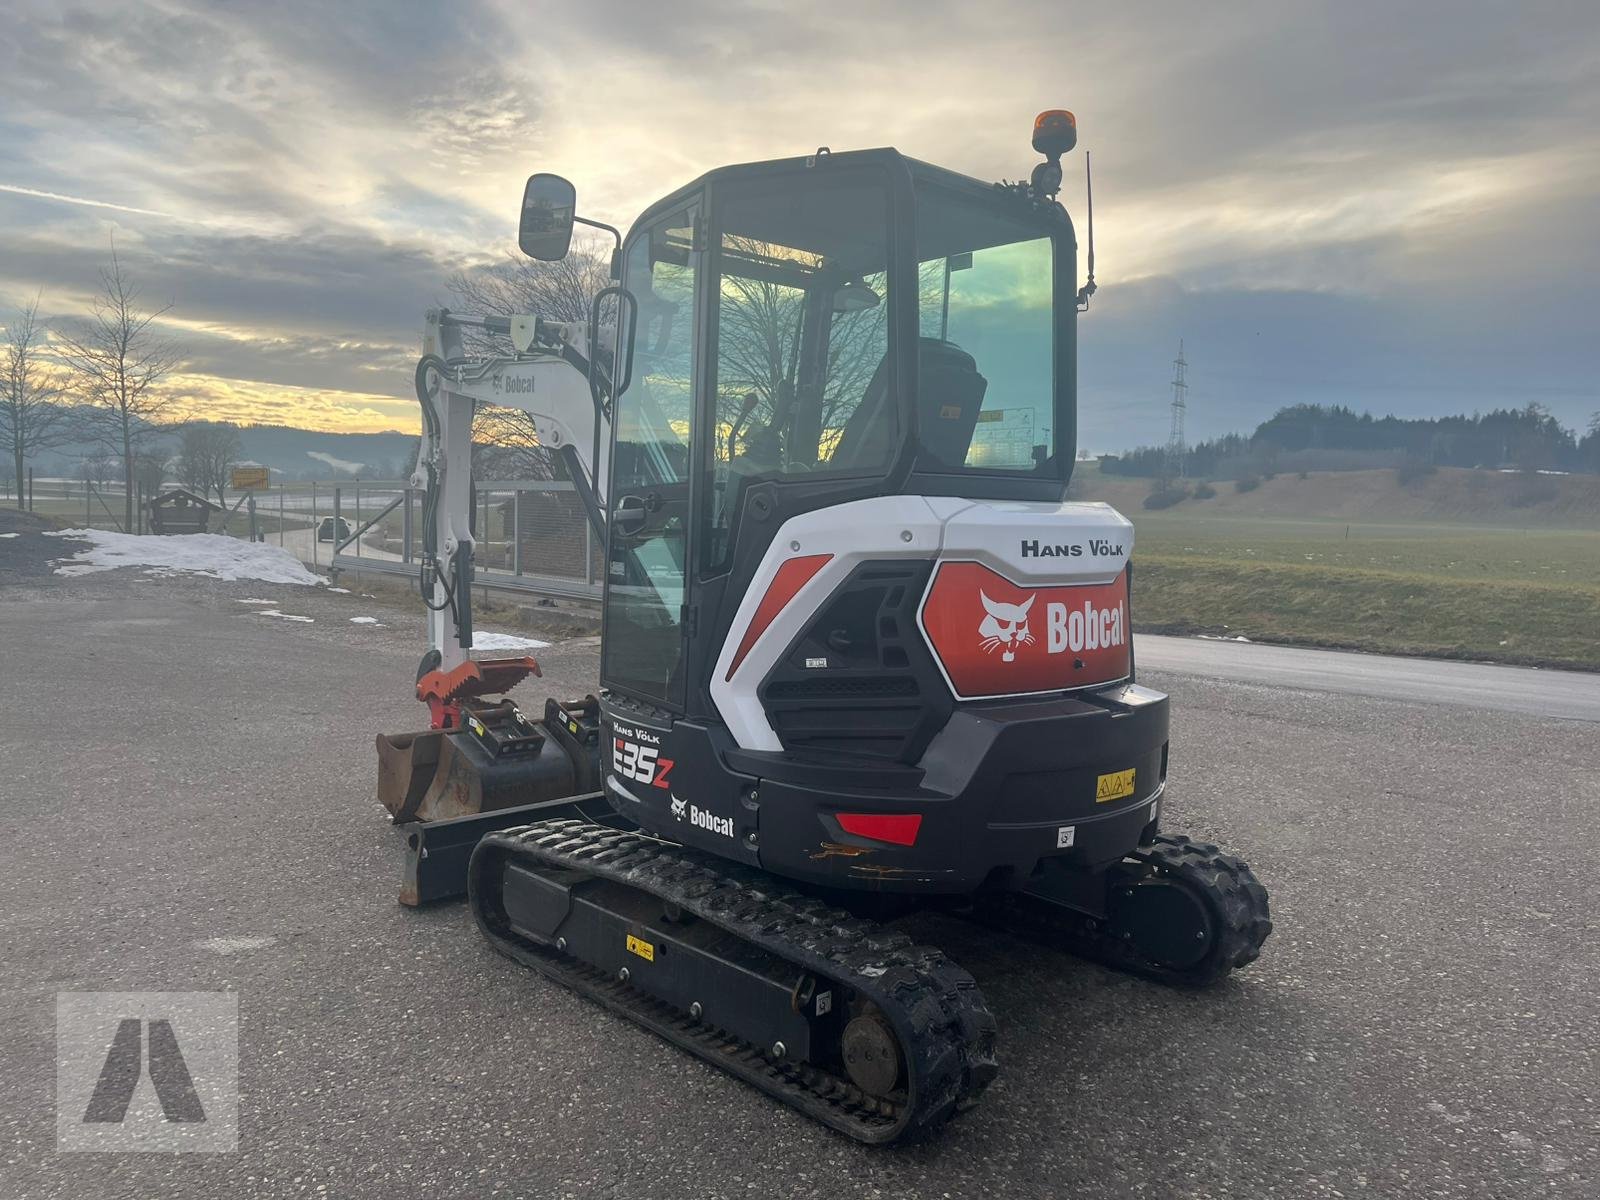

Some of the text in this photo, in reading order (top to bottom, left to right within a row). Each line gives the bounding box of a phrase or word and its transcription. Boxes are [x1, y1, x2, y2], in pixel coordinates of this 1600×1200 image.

[506, 375, 535, 393] Bobcat
[1021, 540, 1082, 557] HANS
[1047, 600, 1124, 654] Bobcat
[690, 805, 734, 838] Bobcat
